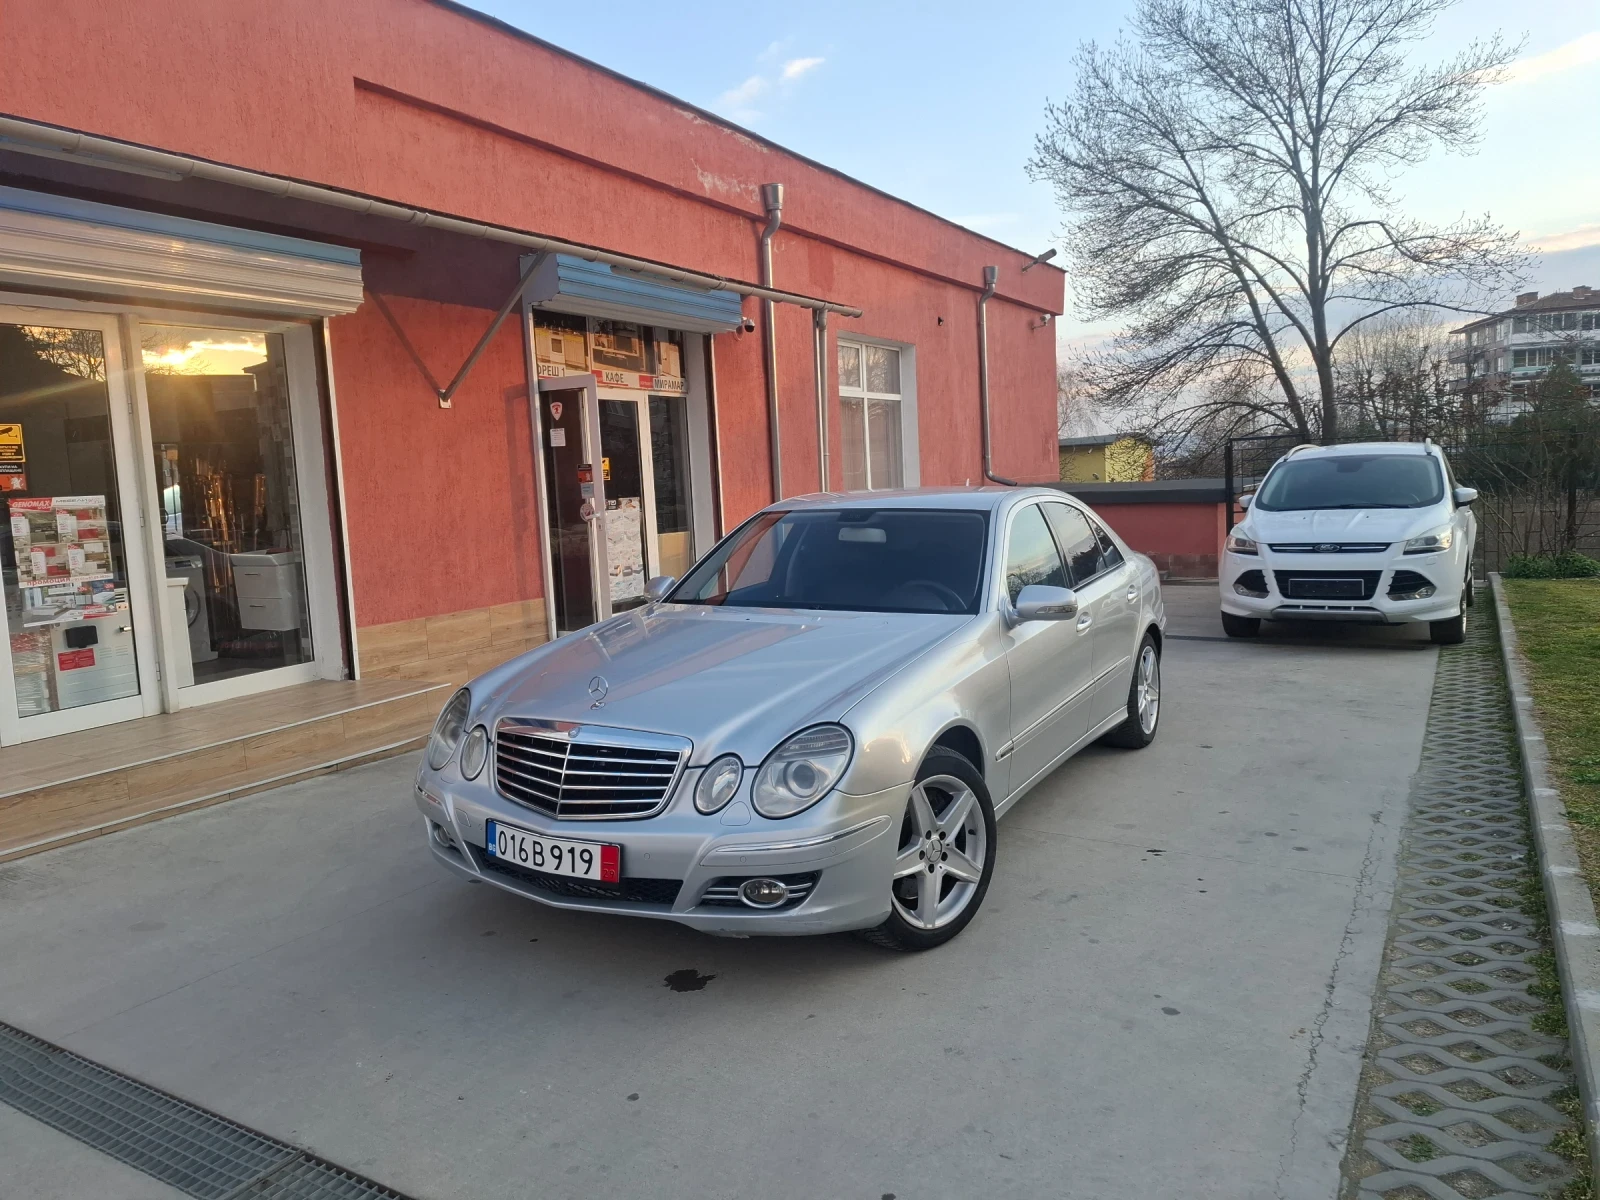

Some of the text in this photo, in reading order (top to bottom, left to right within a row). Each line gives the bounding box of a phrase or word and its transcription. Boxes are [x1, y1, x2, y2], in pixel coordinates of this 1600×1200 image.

[605, 371, 624, 384] КАФЕ
[654, 378, 685, 391] МИРАМАР
[12, 500, 51, 508] GENOMAX
[602, 868, 616, 878] 29
